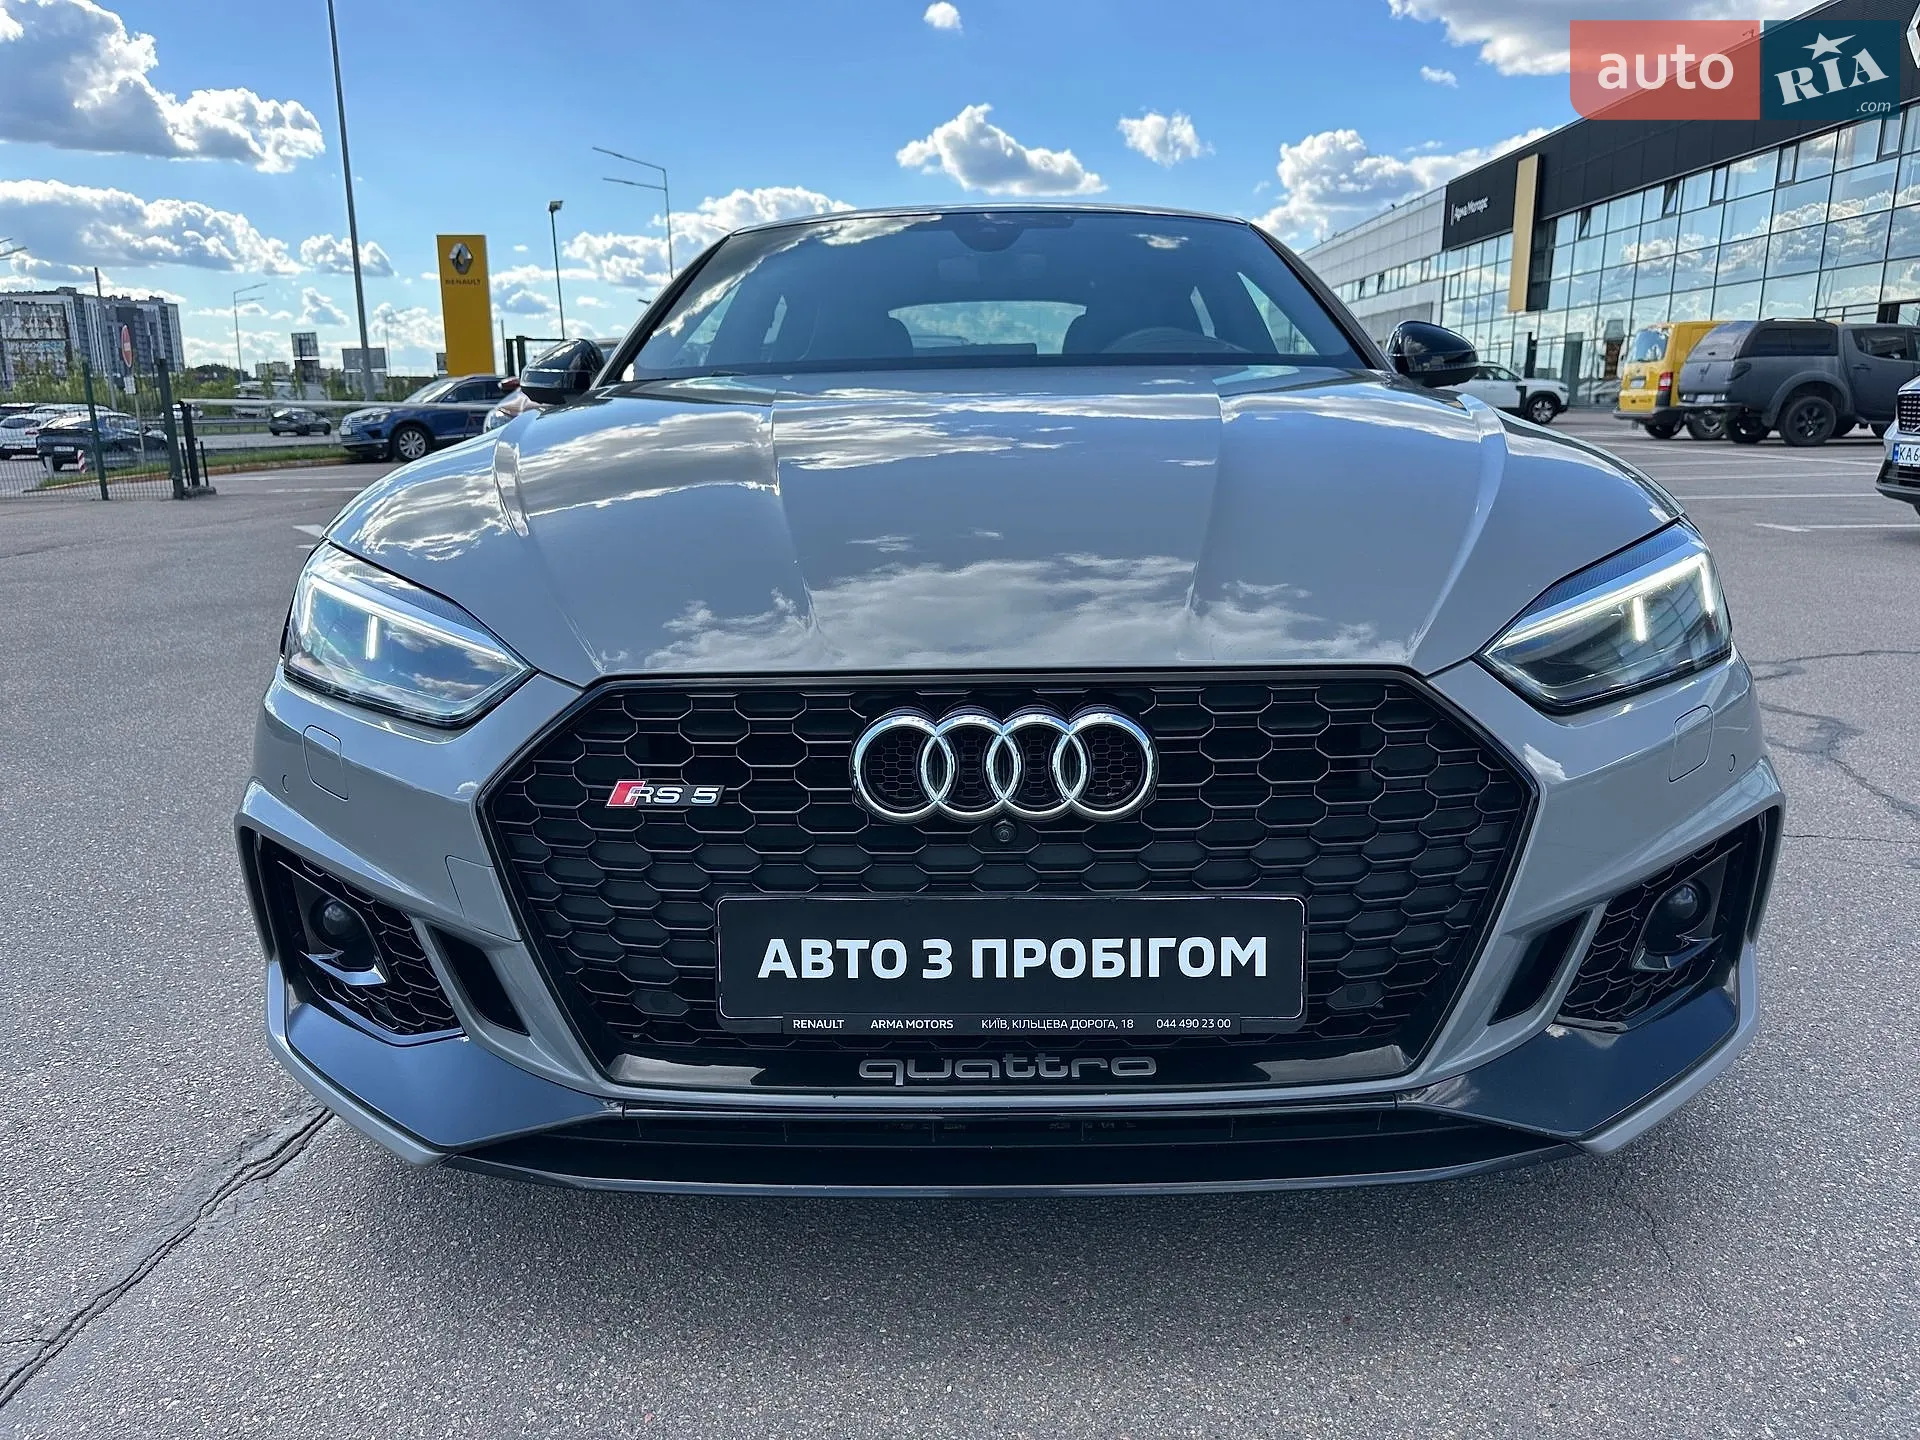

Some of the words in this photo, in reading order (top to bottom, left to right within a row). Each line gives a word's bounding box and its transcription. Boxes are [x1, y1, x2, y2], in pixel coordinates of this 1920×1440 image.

[1899, 447, 1920, 461] KA6
[623, 786, 683, 804] RS
[690, 786, 720, 804] 5
[757, 938, 908, 980] АВТО
[971, 936, 1267, 979] ПРОБІГОМ
[792, 1018, 845, 1029] RENAULT
[870, 1018, 904, 1029] ARMA
[905, 1018, 954, 1029] MOTORS
[981, 1017, 1010, 1030] КИЇВ,
[1012, 1018, 1068, 1030] КІЛЬЦЕВА
[1070, 1018, 1119, 1030] ДОРОГА,
[1121, 1018, 1134, 1029] 18
[1156, 1018, 1176, 1028] 044
[1178, 1018, 1199, 1028] 490
[1201, 1018, 1214, 1028] 23
[1217, 1018, 1231, 1028] 00
[858, 1052, 1157, 1086] quattro
